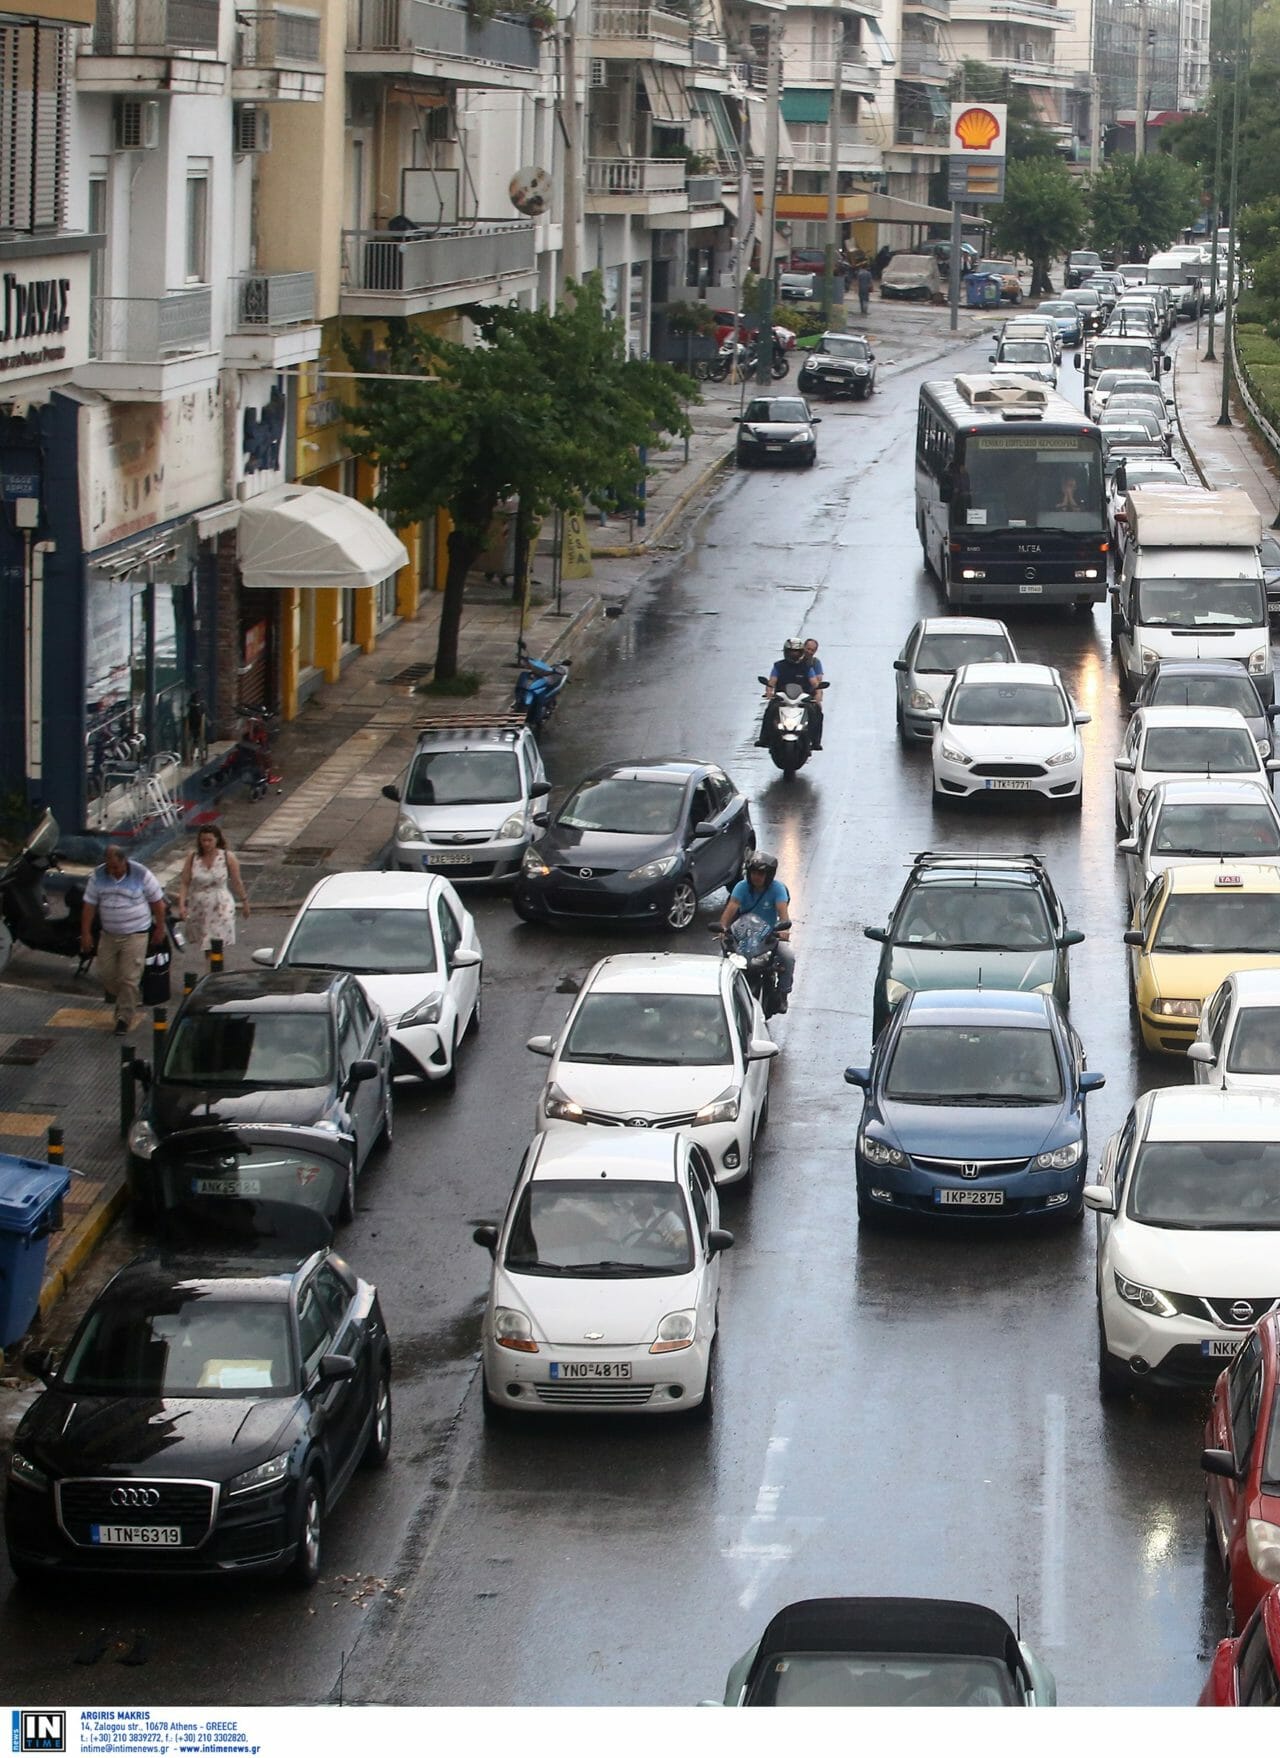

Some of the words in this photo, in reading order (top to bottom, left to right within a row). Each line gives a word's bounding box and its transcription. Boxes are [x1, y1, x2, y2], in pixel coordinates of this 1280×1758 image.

[946, 1191, 1001, 1204] IKP-2875
[562, 1363, 629, 1377] YNO-4815
[106, 1527, 179, 1543] ITN-6319
